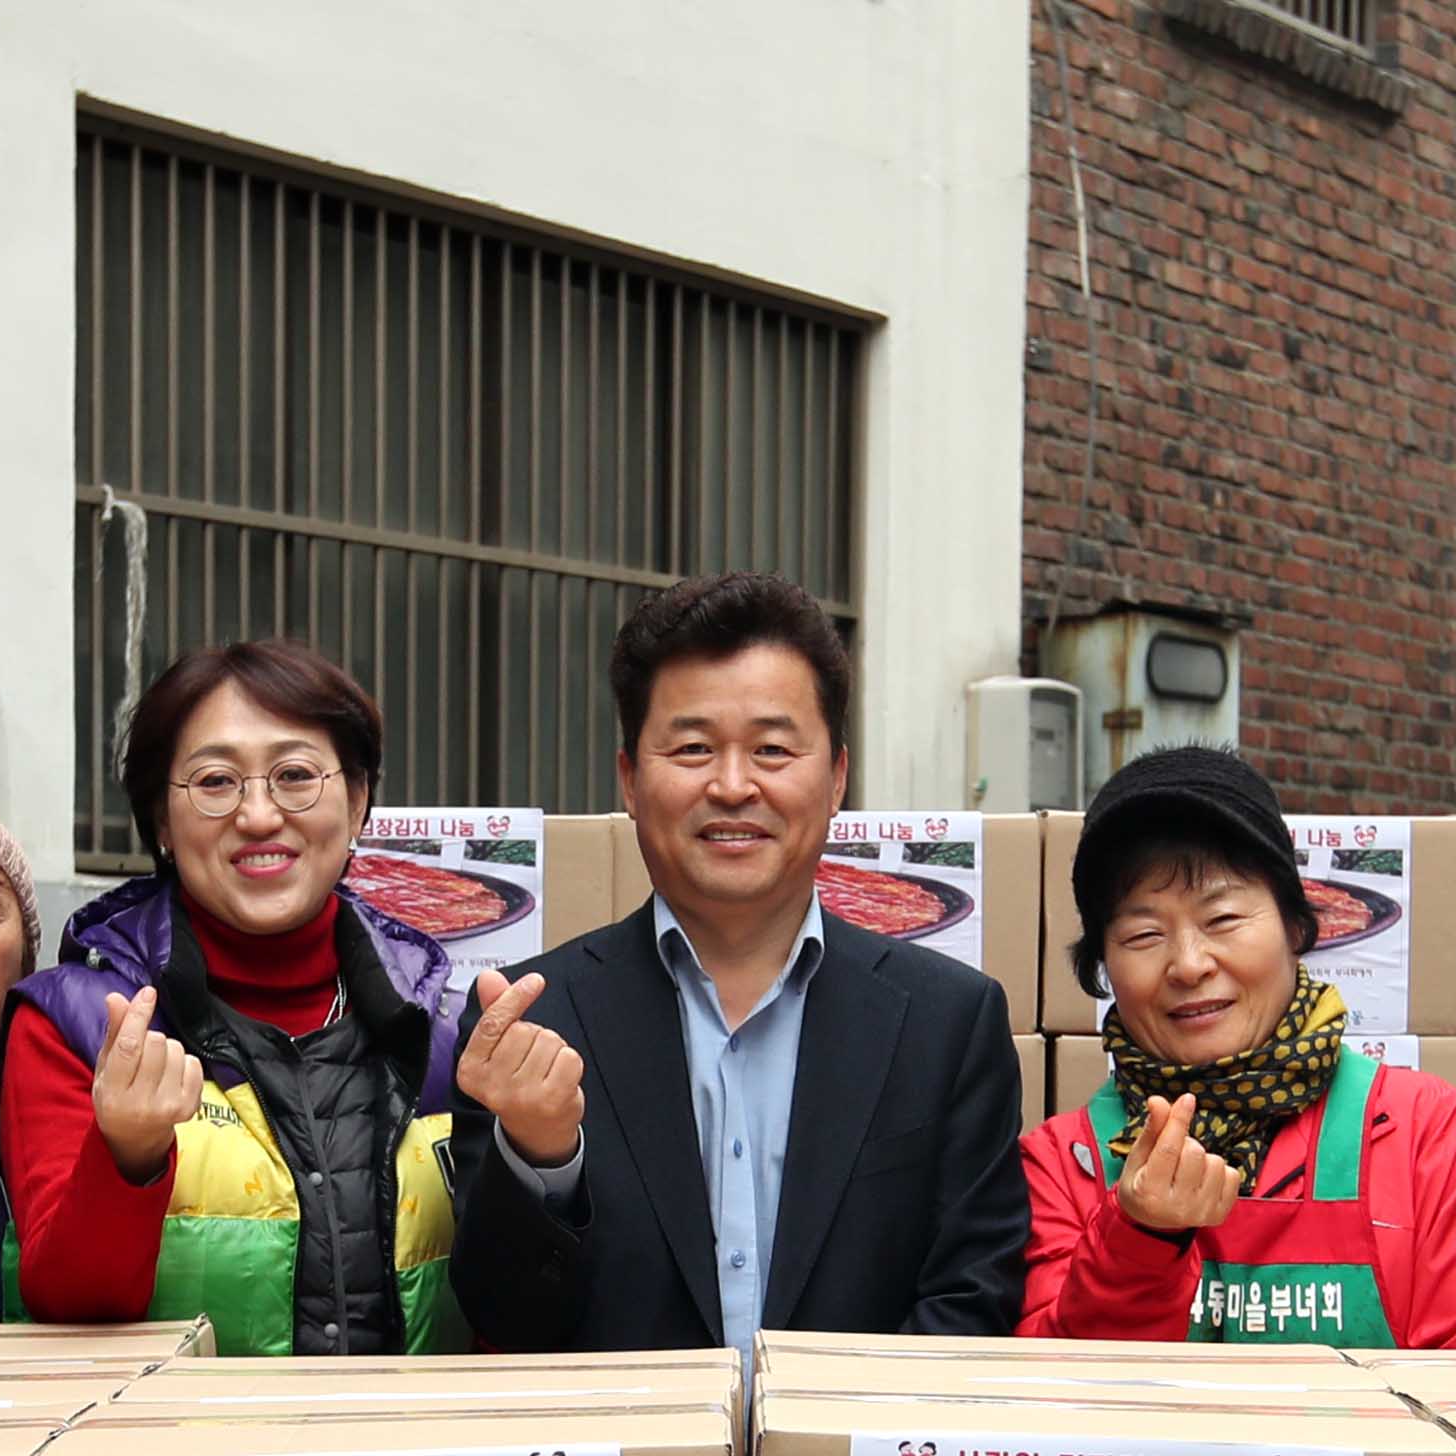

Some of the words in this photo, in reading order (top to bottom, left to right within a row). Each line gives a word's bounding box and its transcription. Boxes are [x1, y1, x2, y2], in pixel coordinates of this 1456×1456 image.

[441, 818, 475, 837] 나눔
[879, 822, 913, 841] 나눔
[1307, 828, 1342, 848] 나눔
